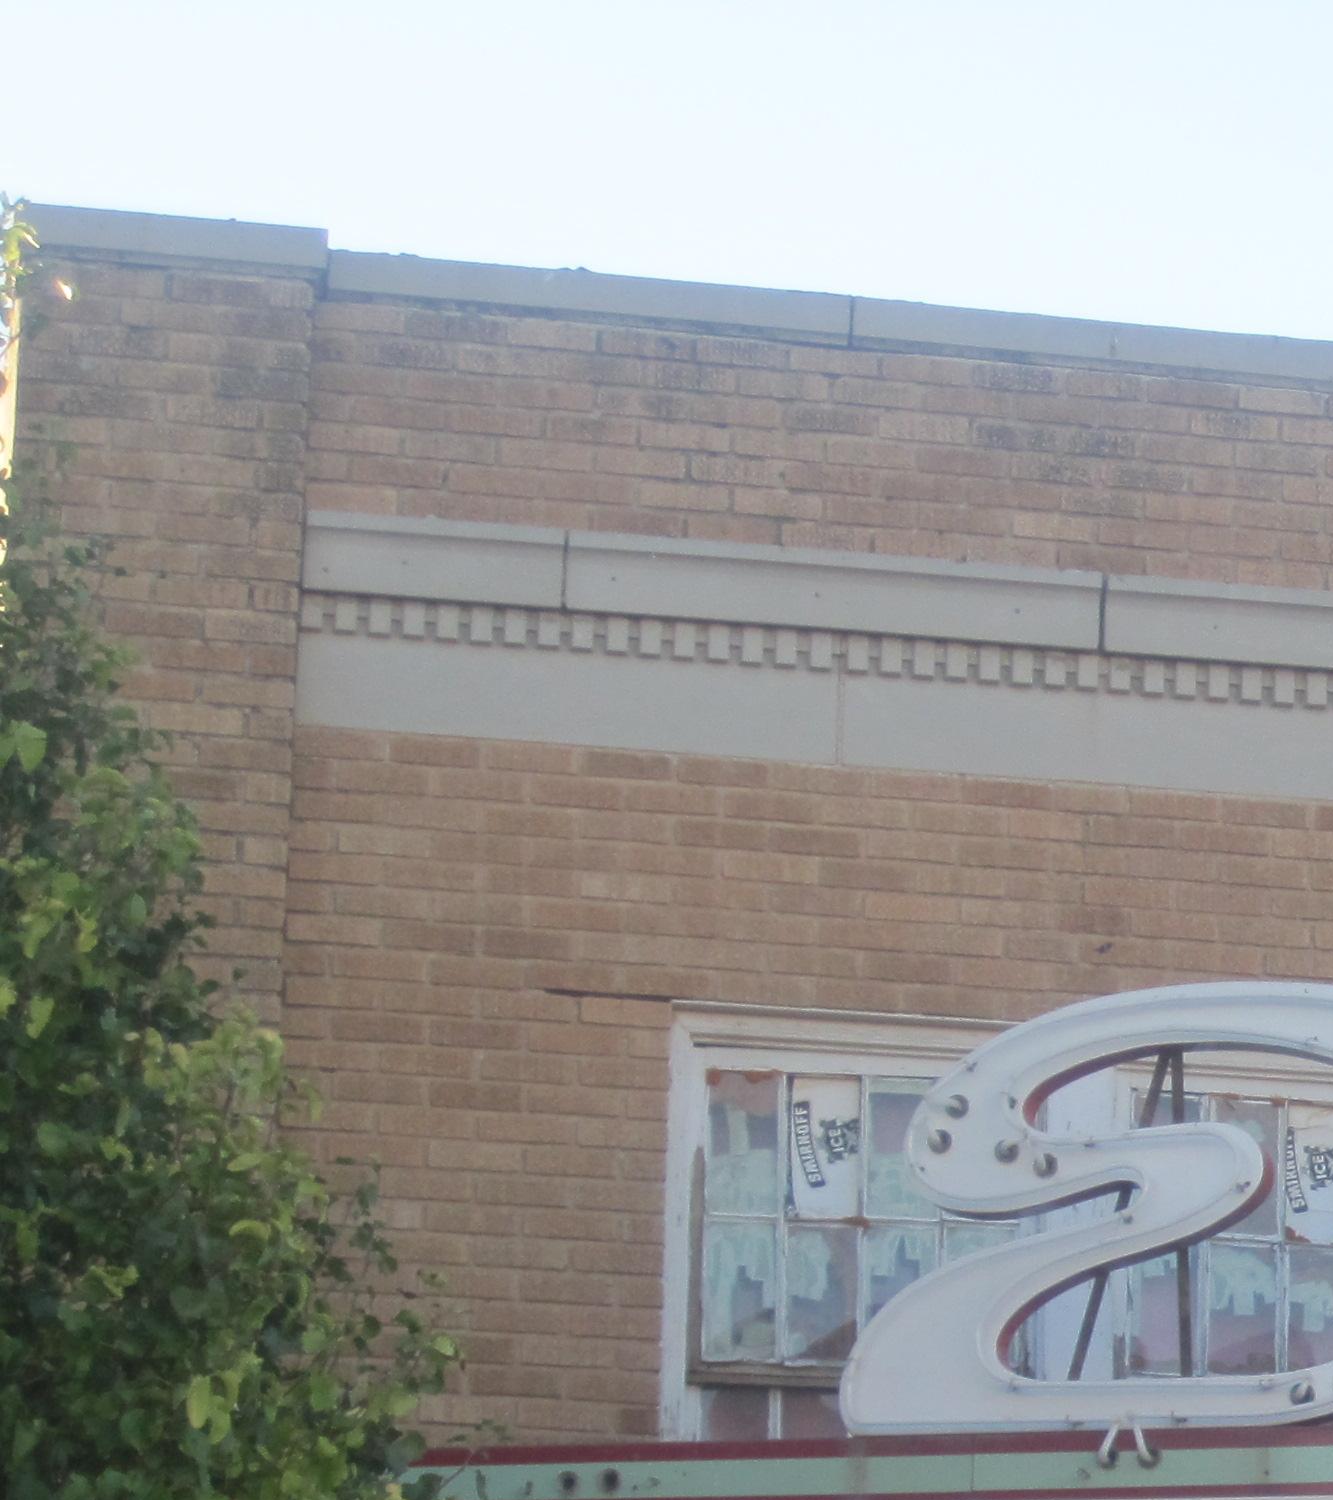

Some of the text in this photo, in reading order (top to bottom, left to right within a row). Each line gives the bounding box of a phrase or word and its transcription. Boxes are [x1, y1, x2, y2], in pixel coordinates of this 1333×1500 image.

[794, 1106, 822, 1184] SMIRNOFF
[828, 1127, 845, 1153] ICE
[1285, 1135, 1306, 1209] SMIRNO
[1312, 1154, 1327, 1180] ICE
